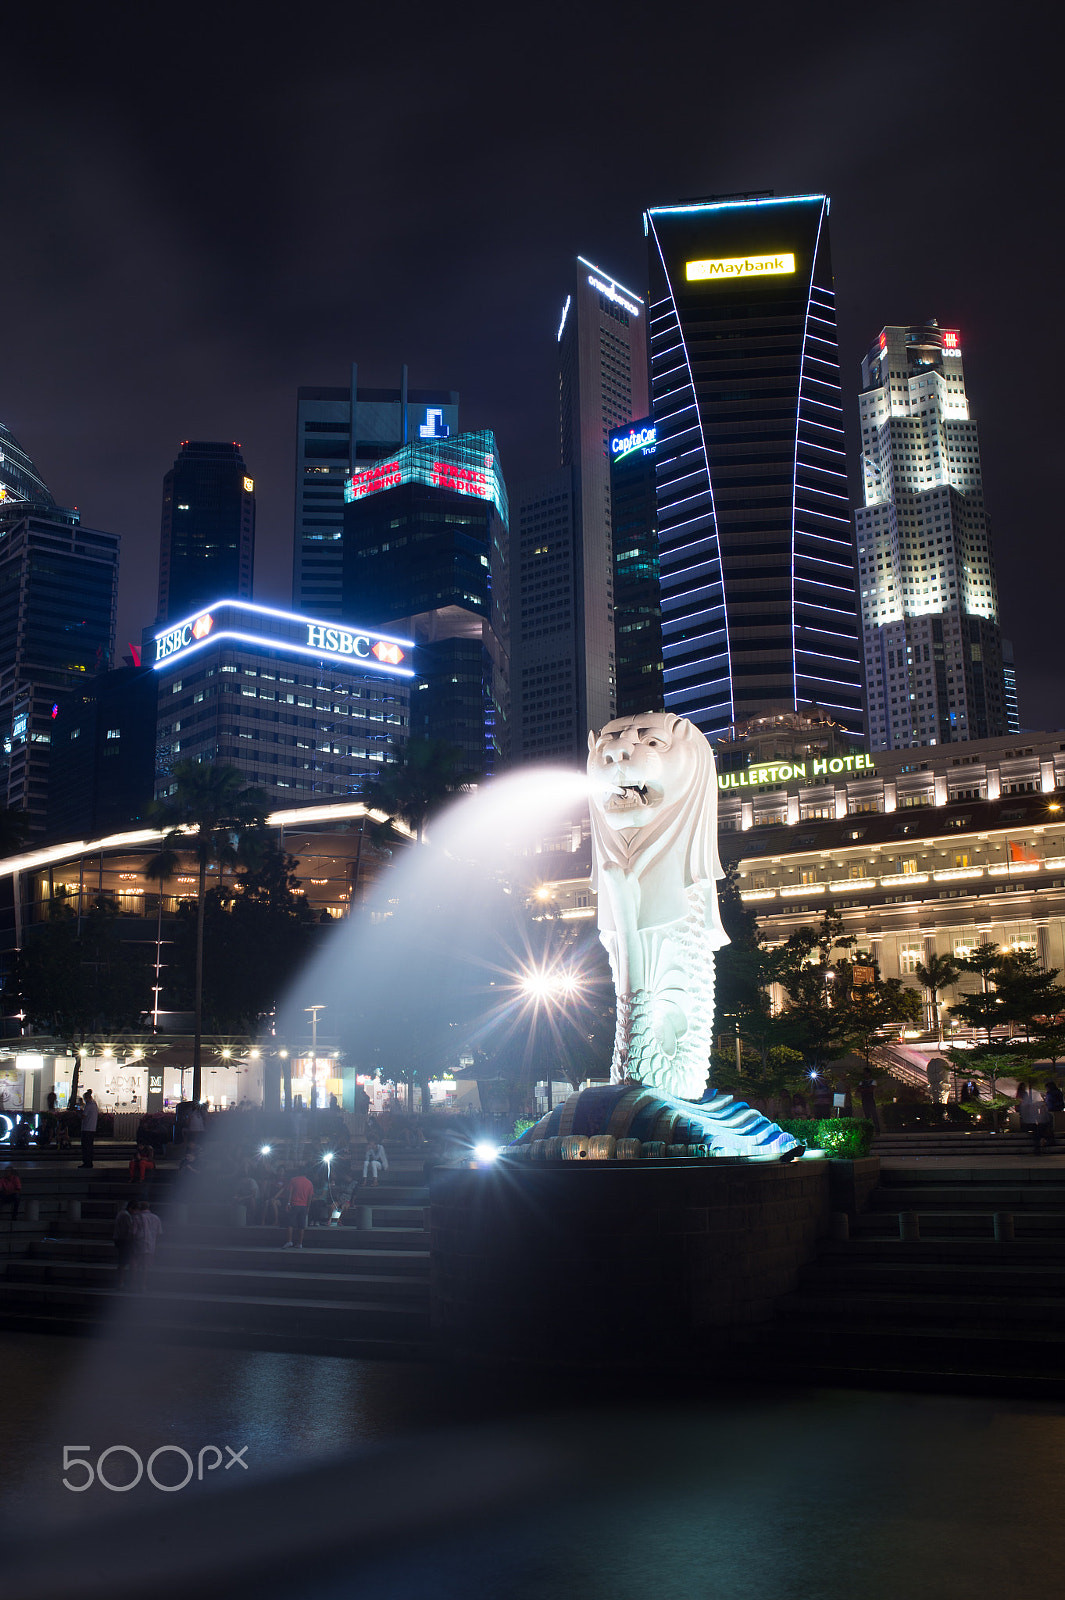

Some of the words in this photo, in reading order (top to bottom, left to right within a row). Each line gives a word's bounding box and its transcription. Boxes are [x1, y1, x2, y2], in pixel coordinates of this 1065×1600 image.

[709, 258, 784, 275] Maybank
[941, 348, 962, 358] UOB
[352, 461, 400, 486] STRAITS
[430, 473, 487, 496] TRADING
[433, 461, 487, 484] STRAITS
[352, 473, 402, 497] TRADING
[155, 623, 193, 661] HSBC
[306, 624, 371, 657] HSBC
[718, 763, 806, 789] ULLERTON
[813, 753, 875, 776] HOTEL
